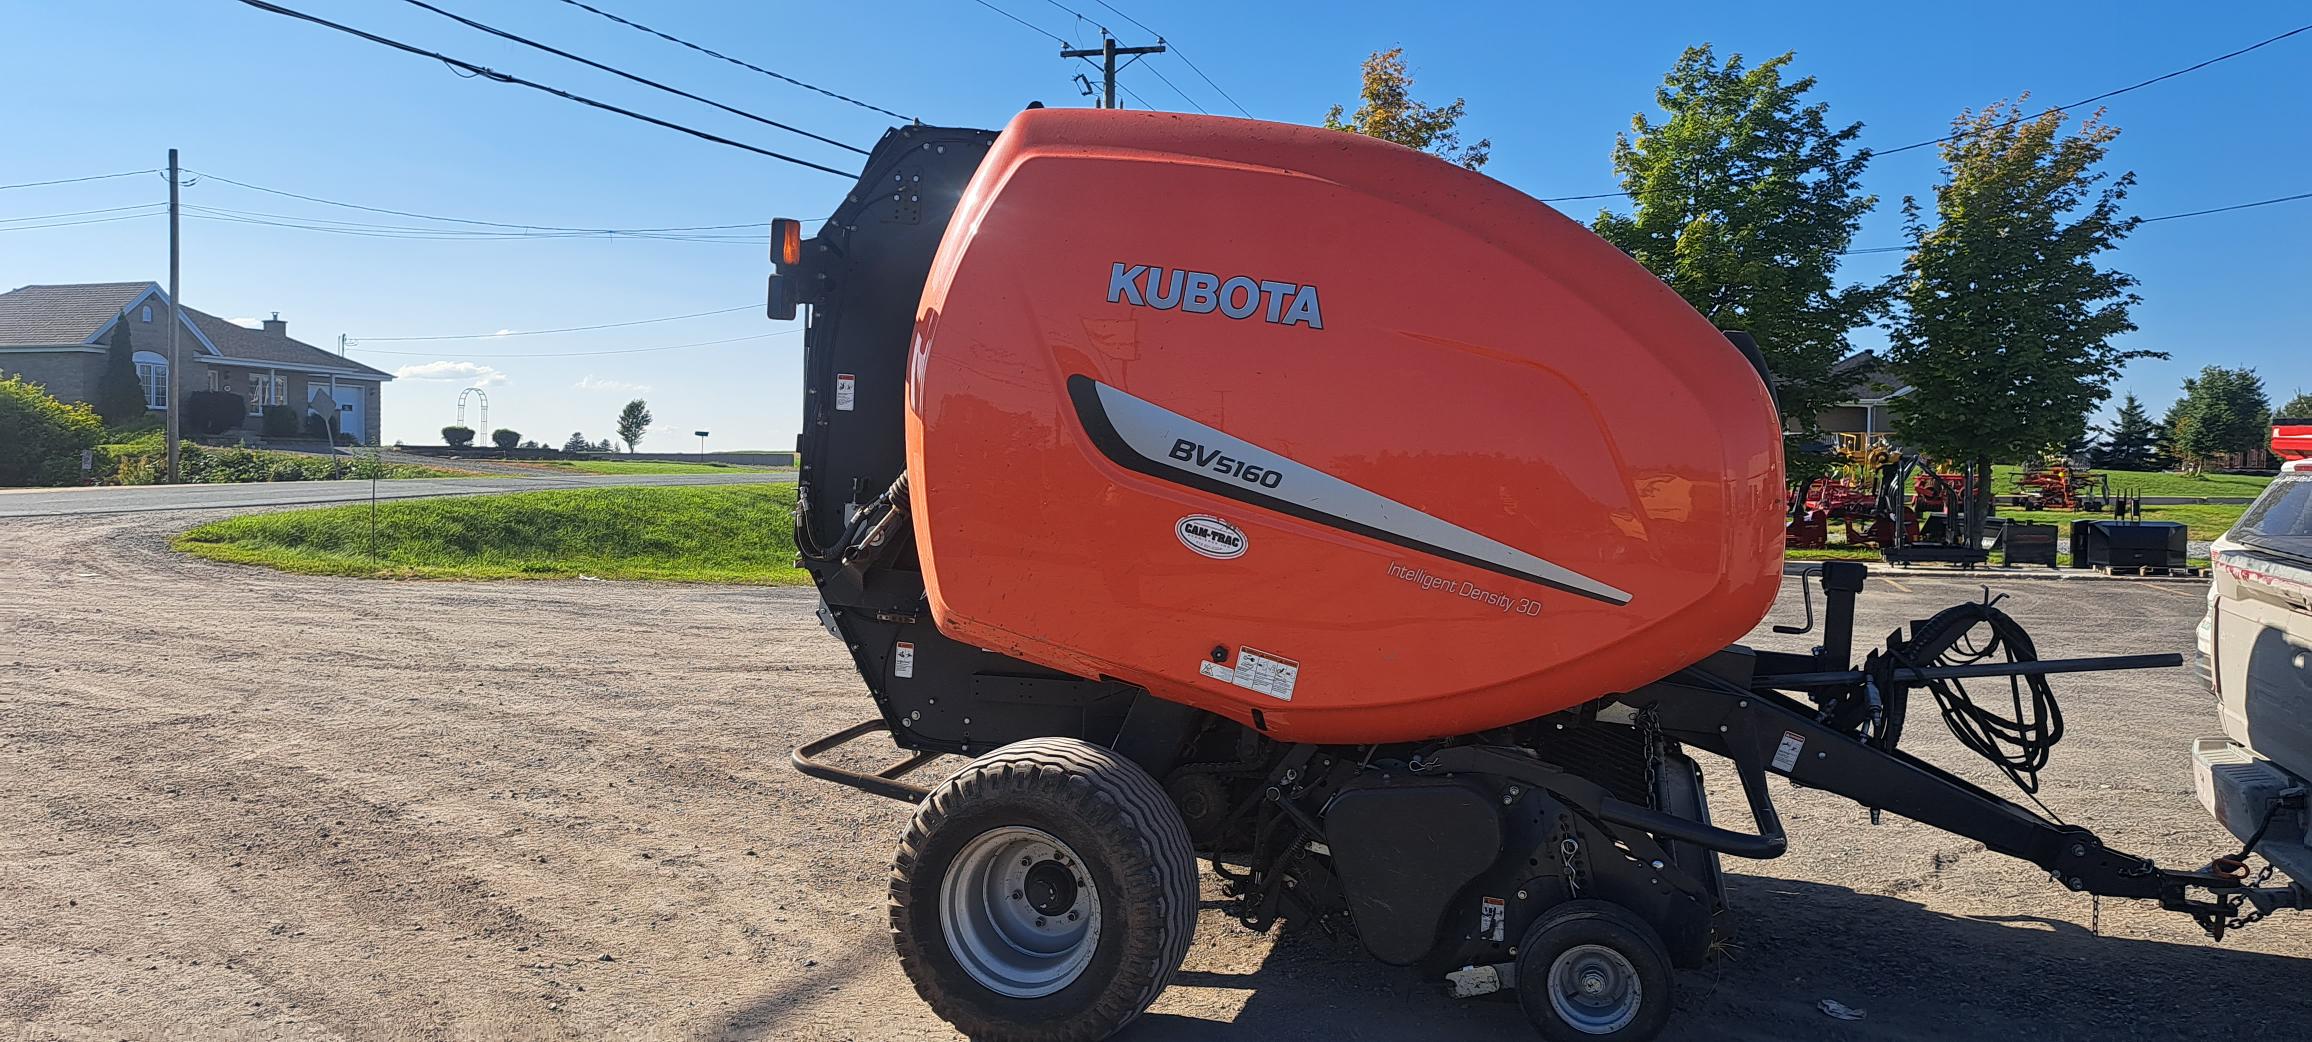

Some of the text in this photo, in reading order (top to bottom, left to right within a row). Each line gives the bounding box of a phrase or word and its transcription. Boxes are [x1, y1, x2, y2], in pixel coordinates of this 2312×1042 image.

[1106, 262, 1324, 330] KUBOTA
[1168, 438, 1283, 489] BV5160
[1184, 523, 1240, 548] CAM-TRAC
[1387, 560, 1542, 617] Intelligent Density 3D
